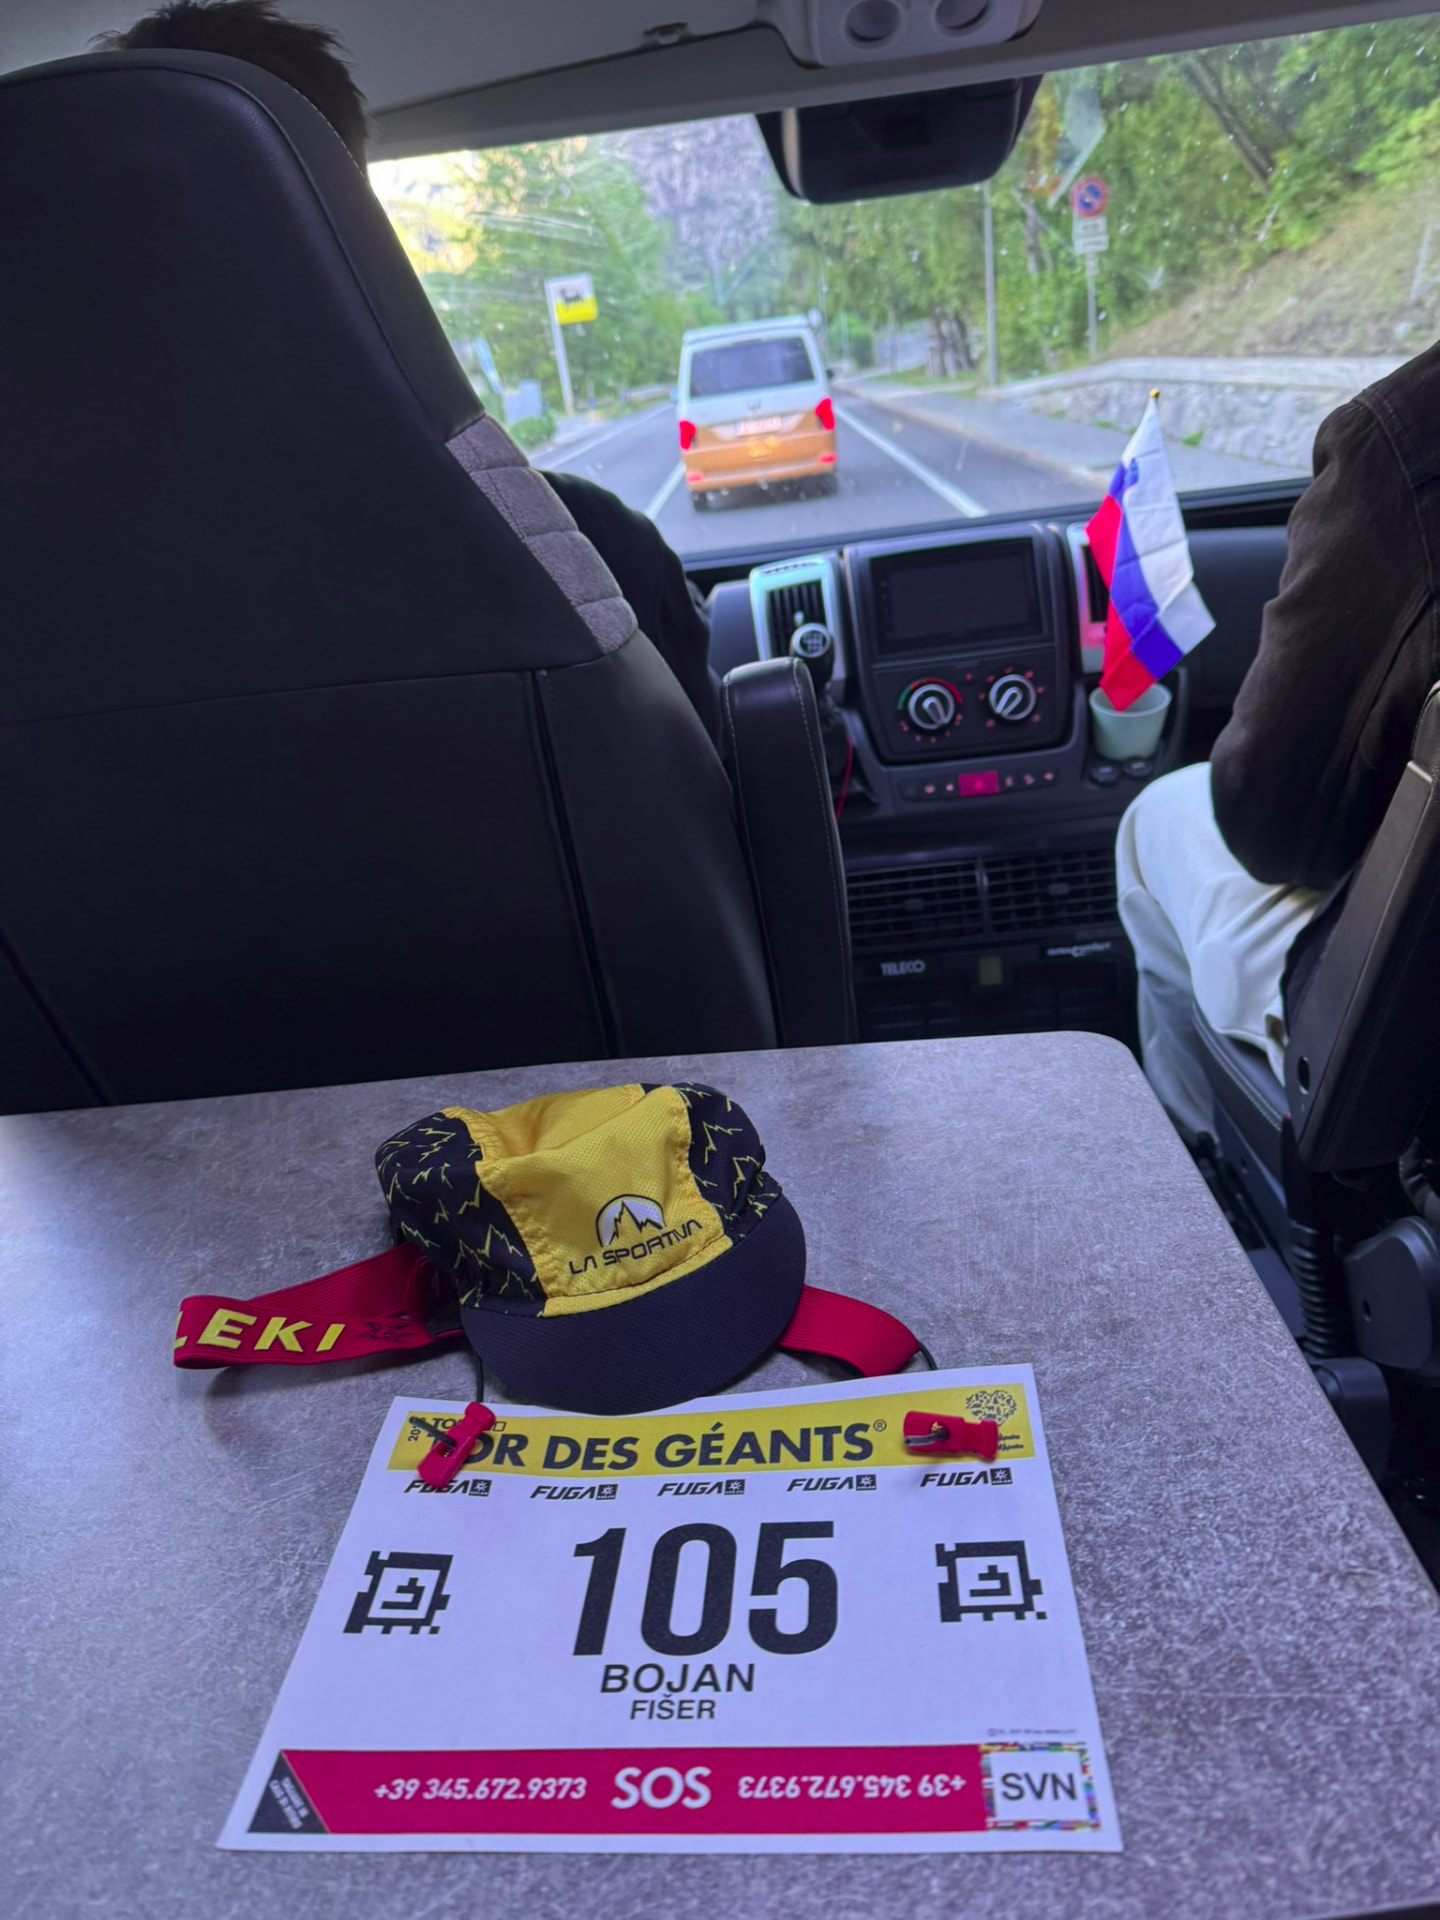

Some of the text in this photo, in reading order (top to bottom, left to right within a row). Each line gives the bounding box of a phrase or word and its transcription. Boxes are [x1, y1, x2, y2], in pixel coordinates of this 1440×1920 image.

[568, 1218, 703, 1275] LA SPORTIVA
[427, 1432, 527, 1468] OR
[543, 1435, 640, 1471] DES
[656, 1481, 724, 1496] FUGA
[786, 1476, 854, 1492] FUGA
[920, 1470, 989, 1487] FUGA
[530, 1485, 597, 1500] FUGA
[572, 1520, 838, 1656] 105
[600, 1662, 755, 1693] BOJAN
[630, 1693, 717, 1720] FIŠER
[374, 1776, 588, 1800] +39 345.672.9373
[611, 1766, 712, 1809] SOS
[737, 1773, 967, 1799] +39 345.672.9373
[1000, 1772, 1078, 1801] SVN
